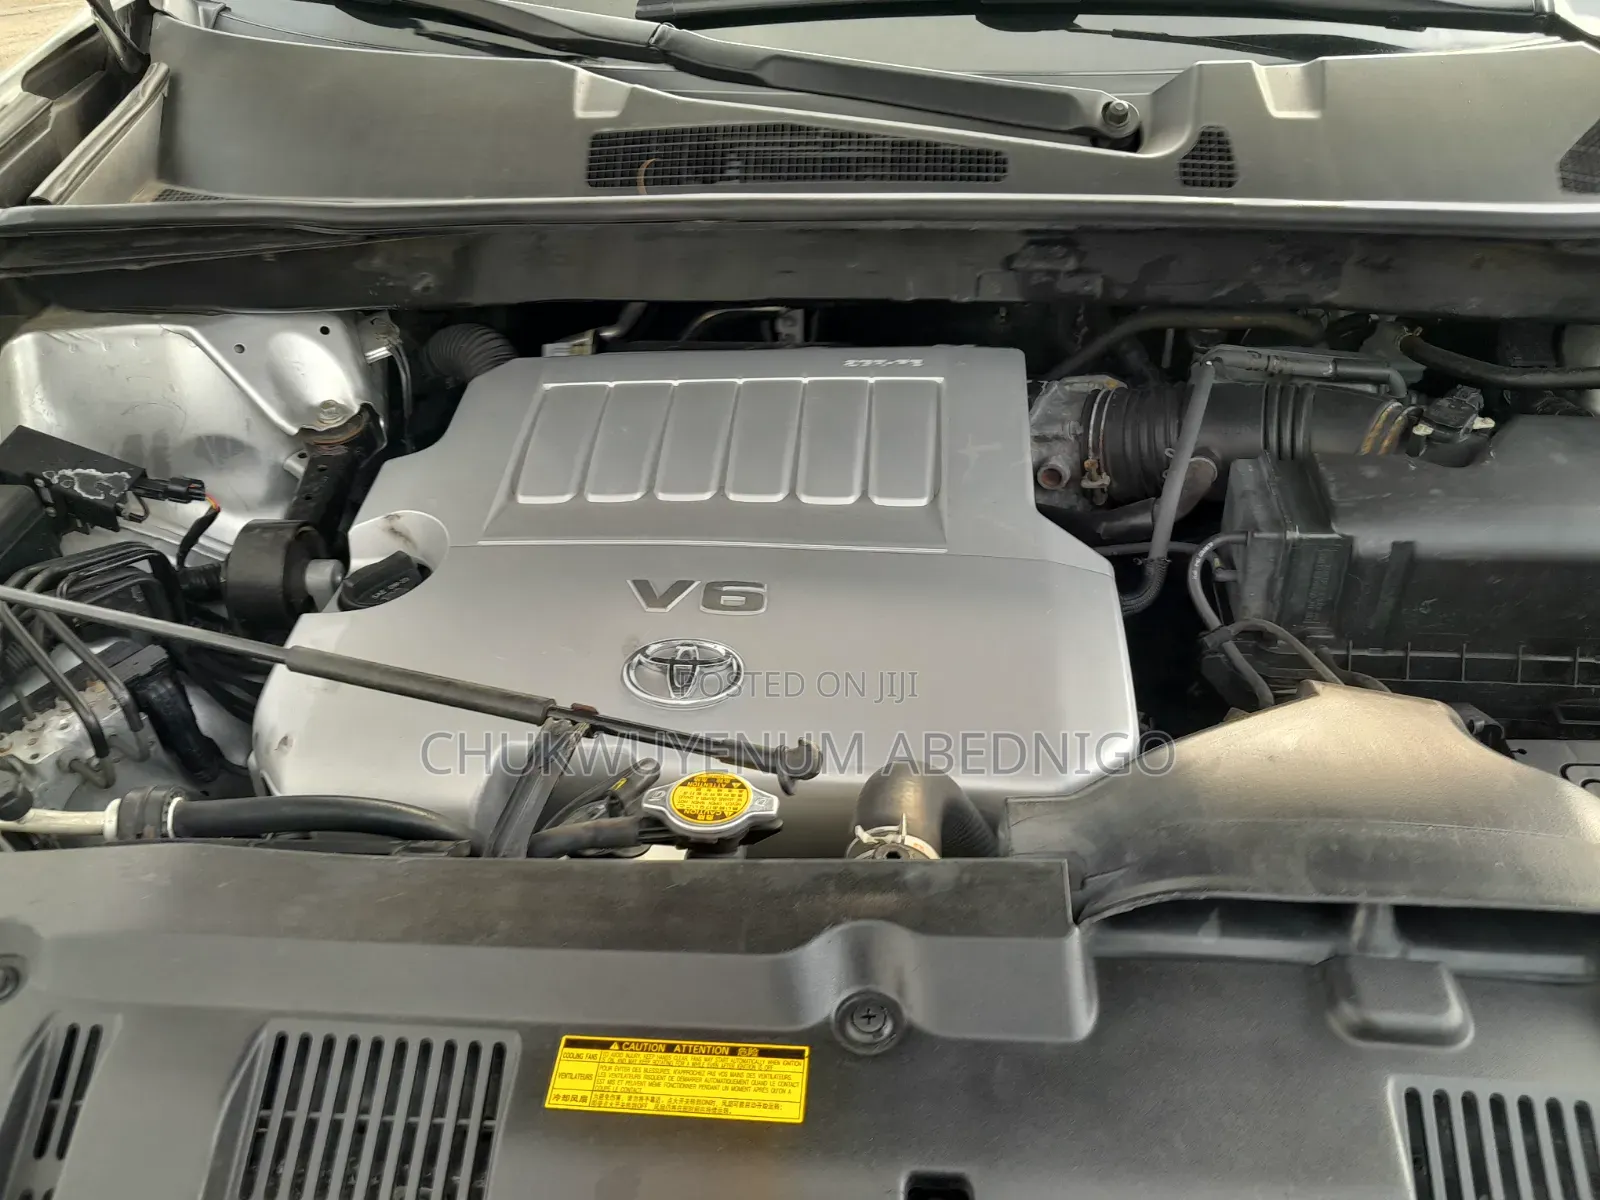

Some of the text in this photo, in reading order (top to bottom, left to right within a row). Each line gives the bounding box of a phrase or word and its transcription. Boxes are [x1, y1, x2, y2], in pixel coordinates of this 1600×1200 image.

[626, 579, 768, 616] V6
[684, 808, 722, 816] CAUTION
[622, 1042, 665, 1051] CAUTION
[673, 1044, 729, 1054] ATTENTION
[557, 1072, 593, 1080] VENTILATEURS
